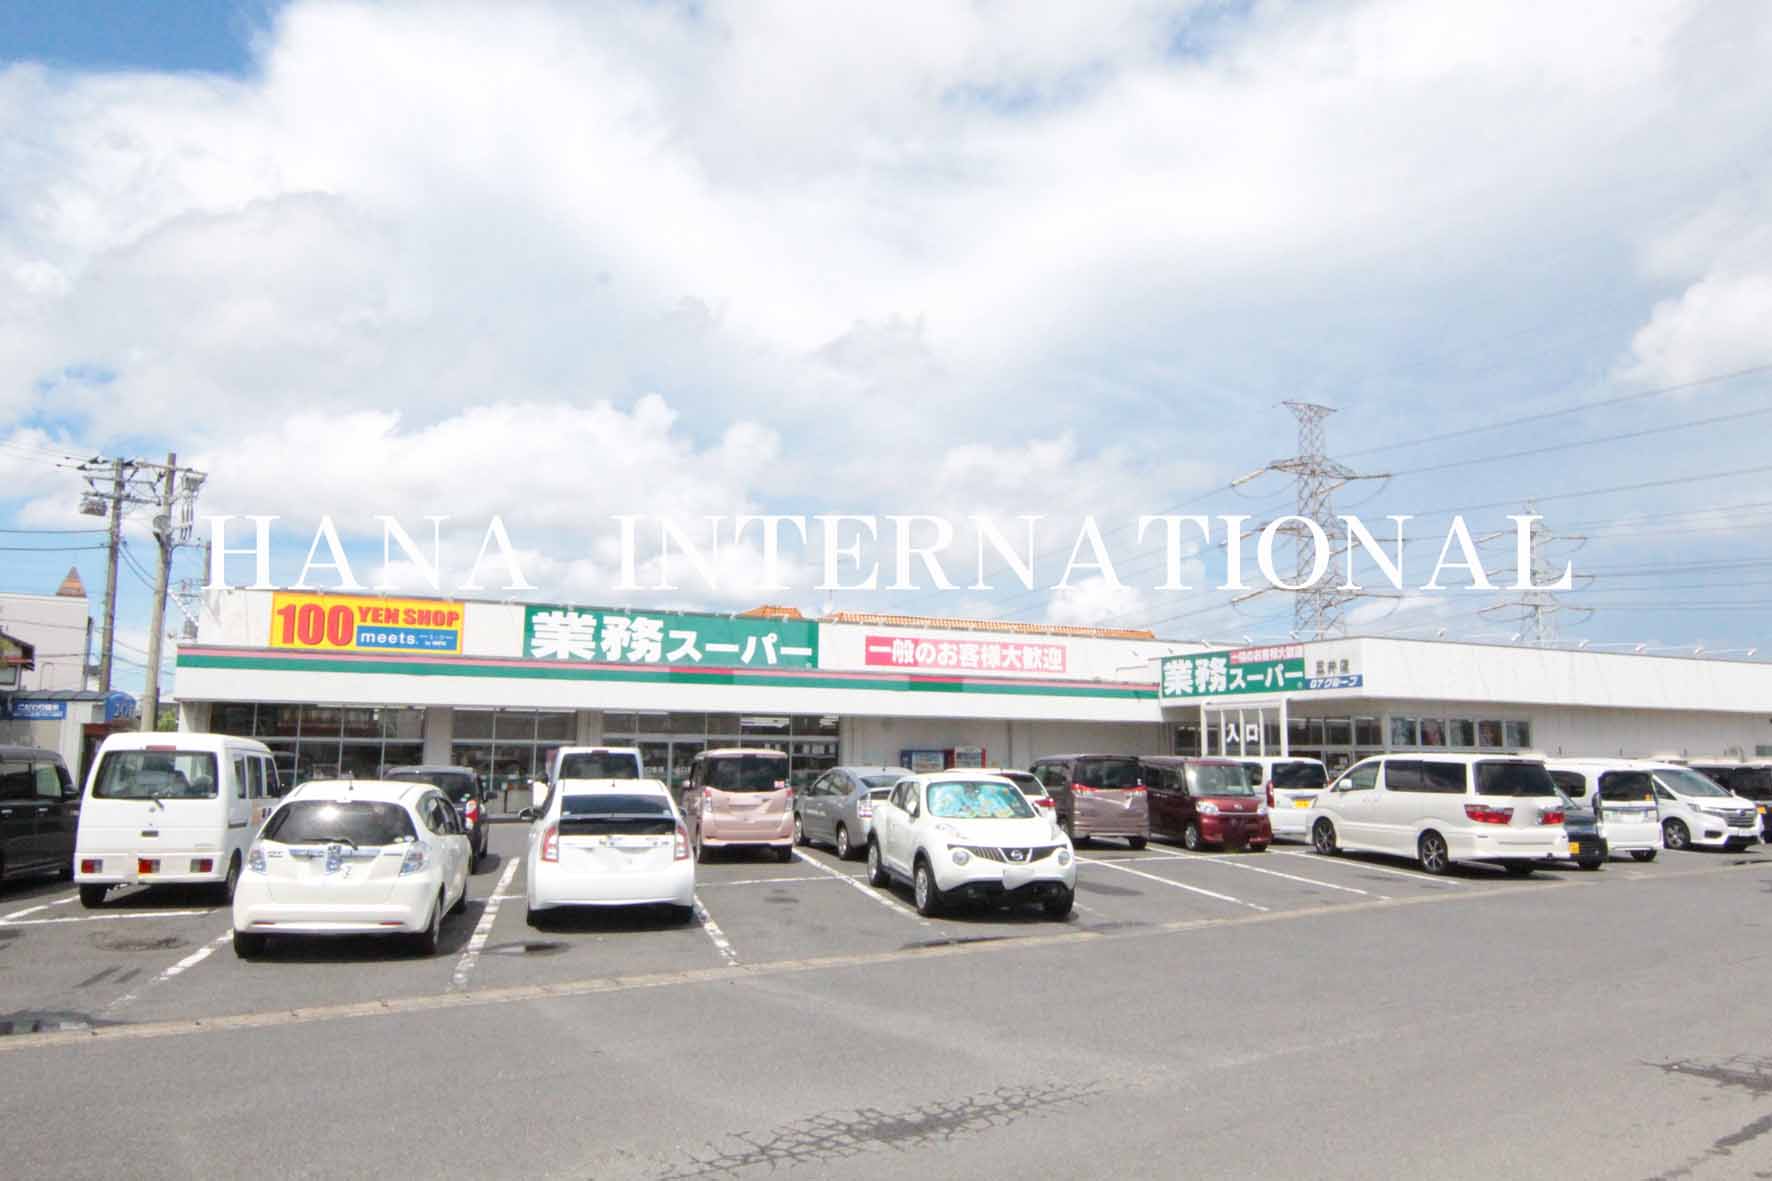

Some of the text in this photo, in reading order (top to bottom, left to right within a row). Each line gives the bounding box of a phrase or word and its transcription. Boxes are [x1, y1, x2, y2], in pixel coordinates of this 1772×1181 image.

[277, 603, 460, 646] 100 YEN SHOP
[530, 611, 812, 665] 業務スーパー
[1163, 656, 1304, 696] 業務スーパー
[1226, 723, 1259, 742] 入口
